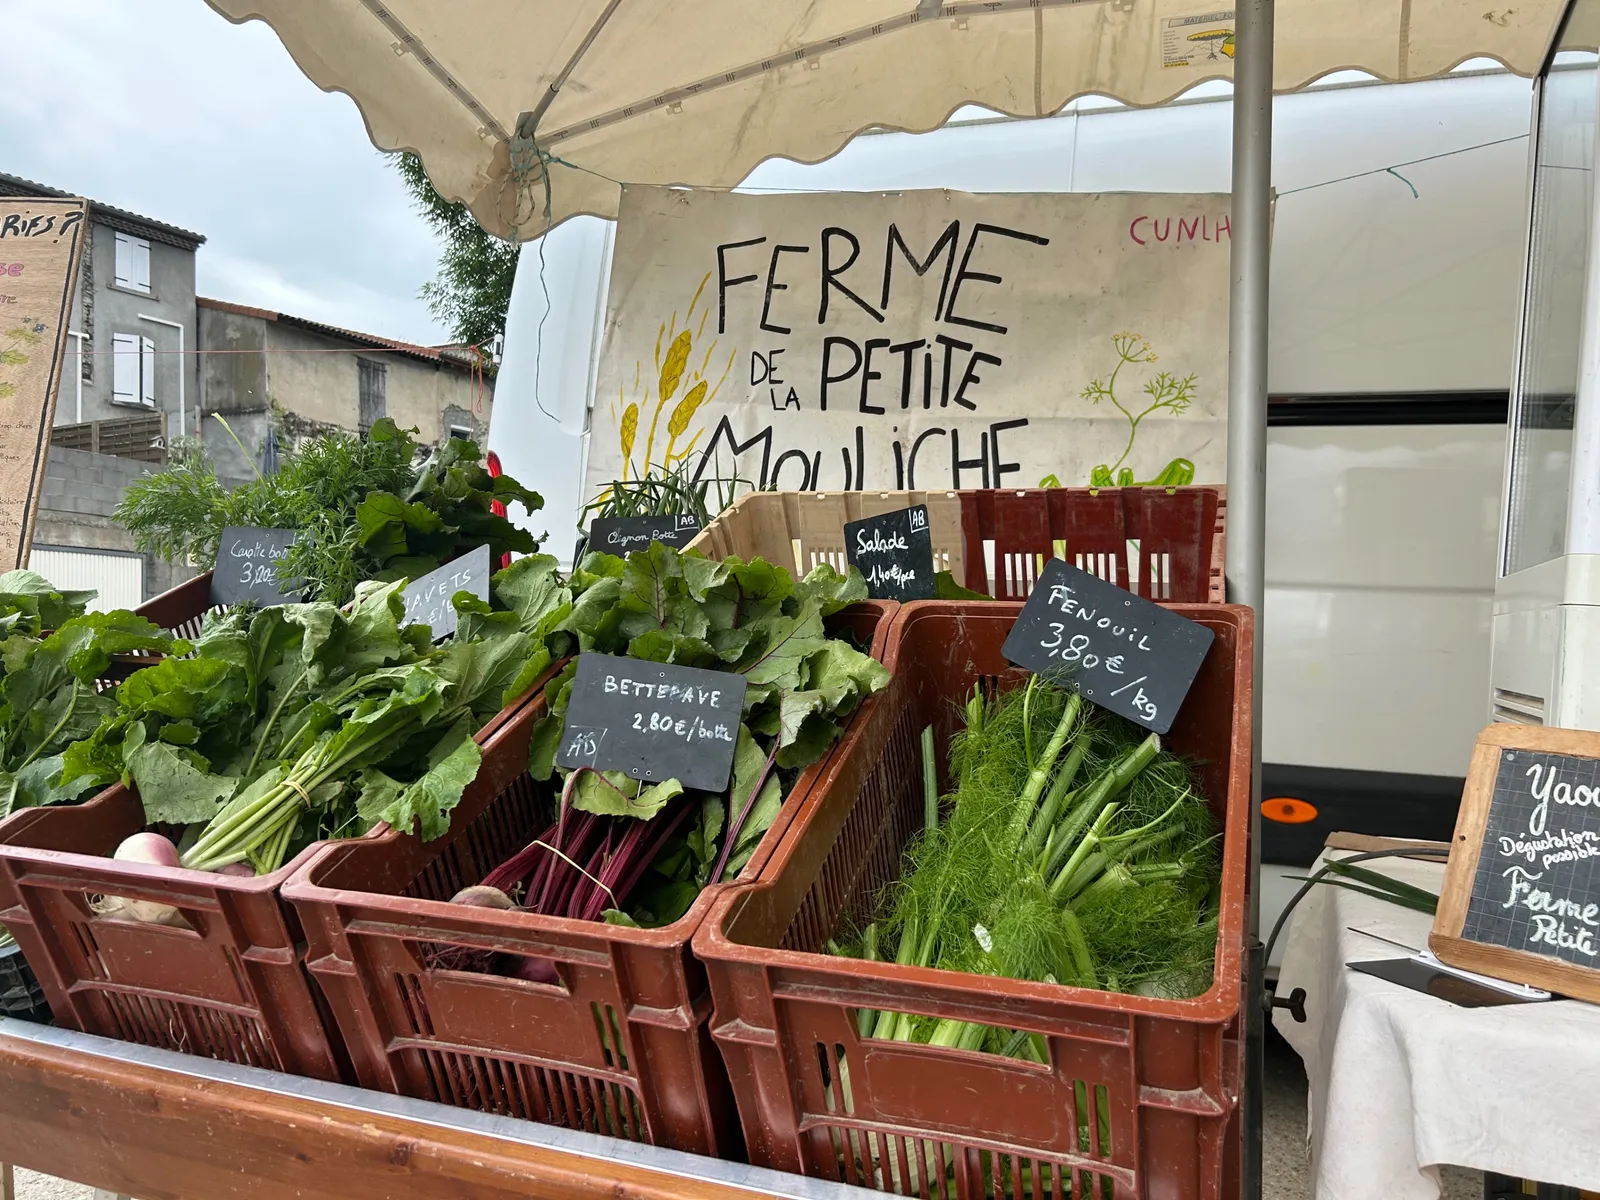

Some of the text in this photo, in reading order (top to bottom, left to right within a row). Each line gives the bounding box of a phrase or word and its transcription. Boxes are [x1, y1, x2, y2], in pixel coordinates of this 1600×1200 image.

[716, 219, 1050, 335] FERME
[751, 348, 786, 386] DE
[770, 386, 801, 412] LA
[680, 514, 696, 526] AB
[912, 509, 926, 528] AB
[607, 528, 649, 547] Oignon
[856, 528, 909, 557] Salade
[1498, 828, 1600, 863] Dégustation
[1542, 842, 1600, 870] possible
[1502, 865, 1600, 926] Ferme
[1529, 914, 1599, 957] Petite
